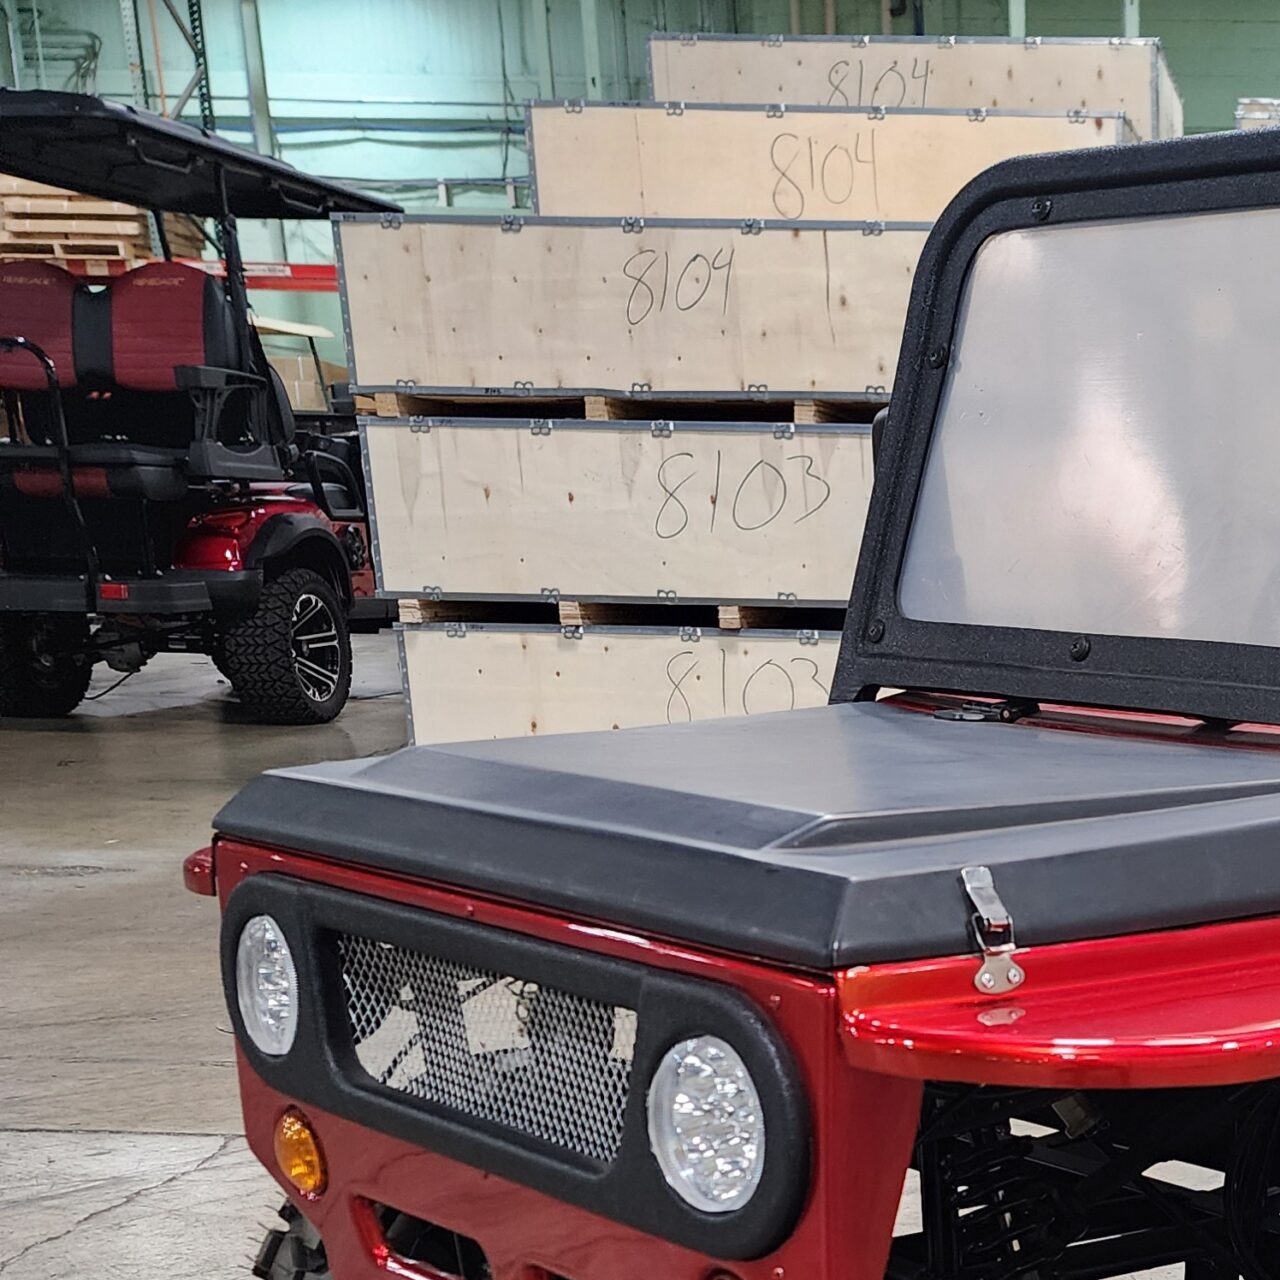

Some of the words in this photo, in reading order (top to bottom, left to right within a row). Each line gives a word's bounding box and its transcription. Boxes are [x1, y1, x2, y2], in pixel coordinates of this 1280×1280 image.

[827, 57, 930, 108] 8104
[770, 128, 880, 220] 8104
[655, 450, 831, 539] 8103
